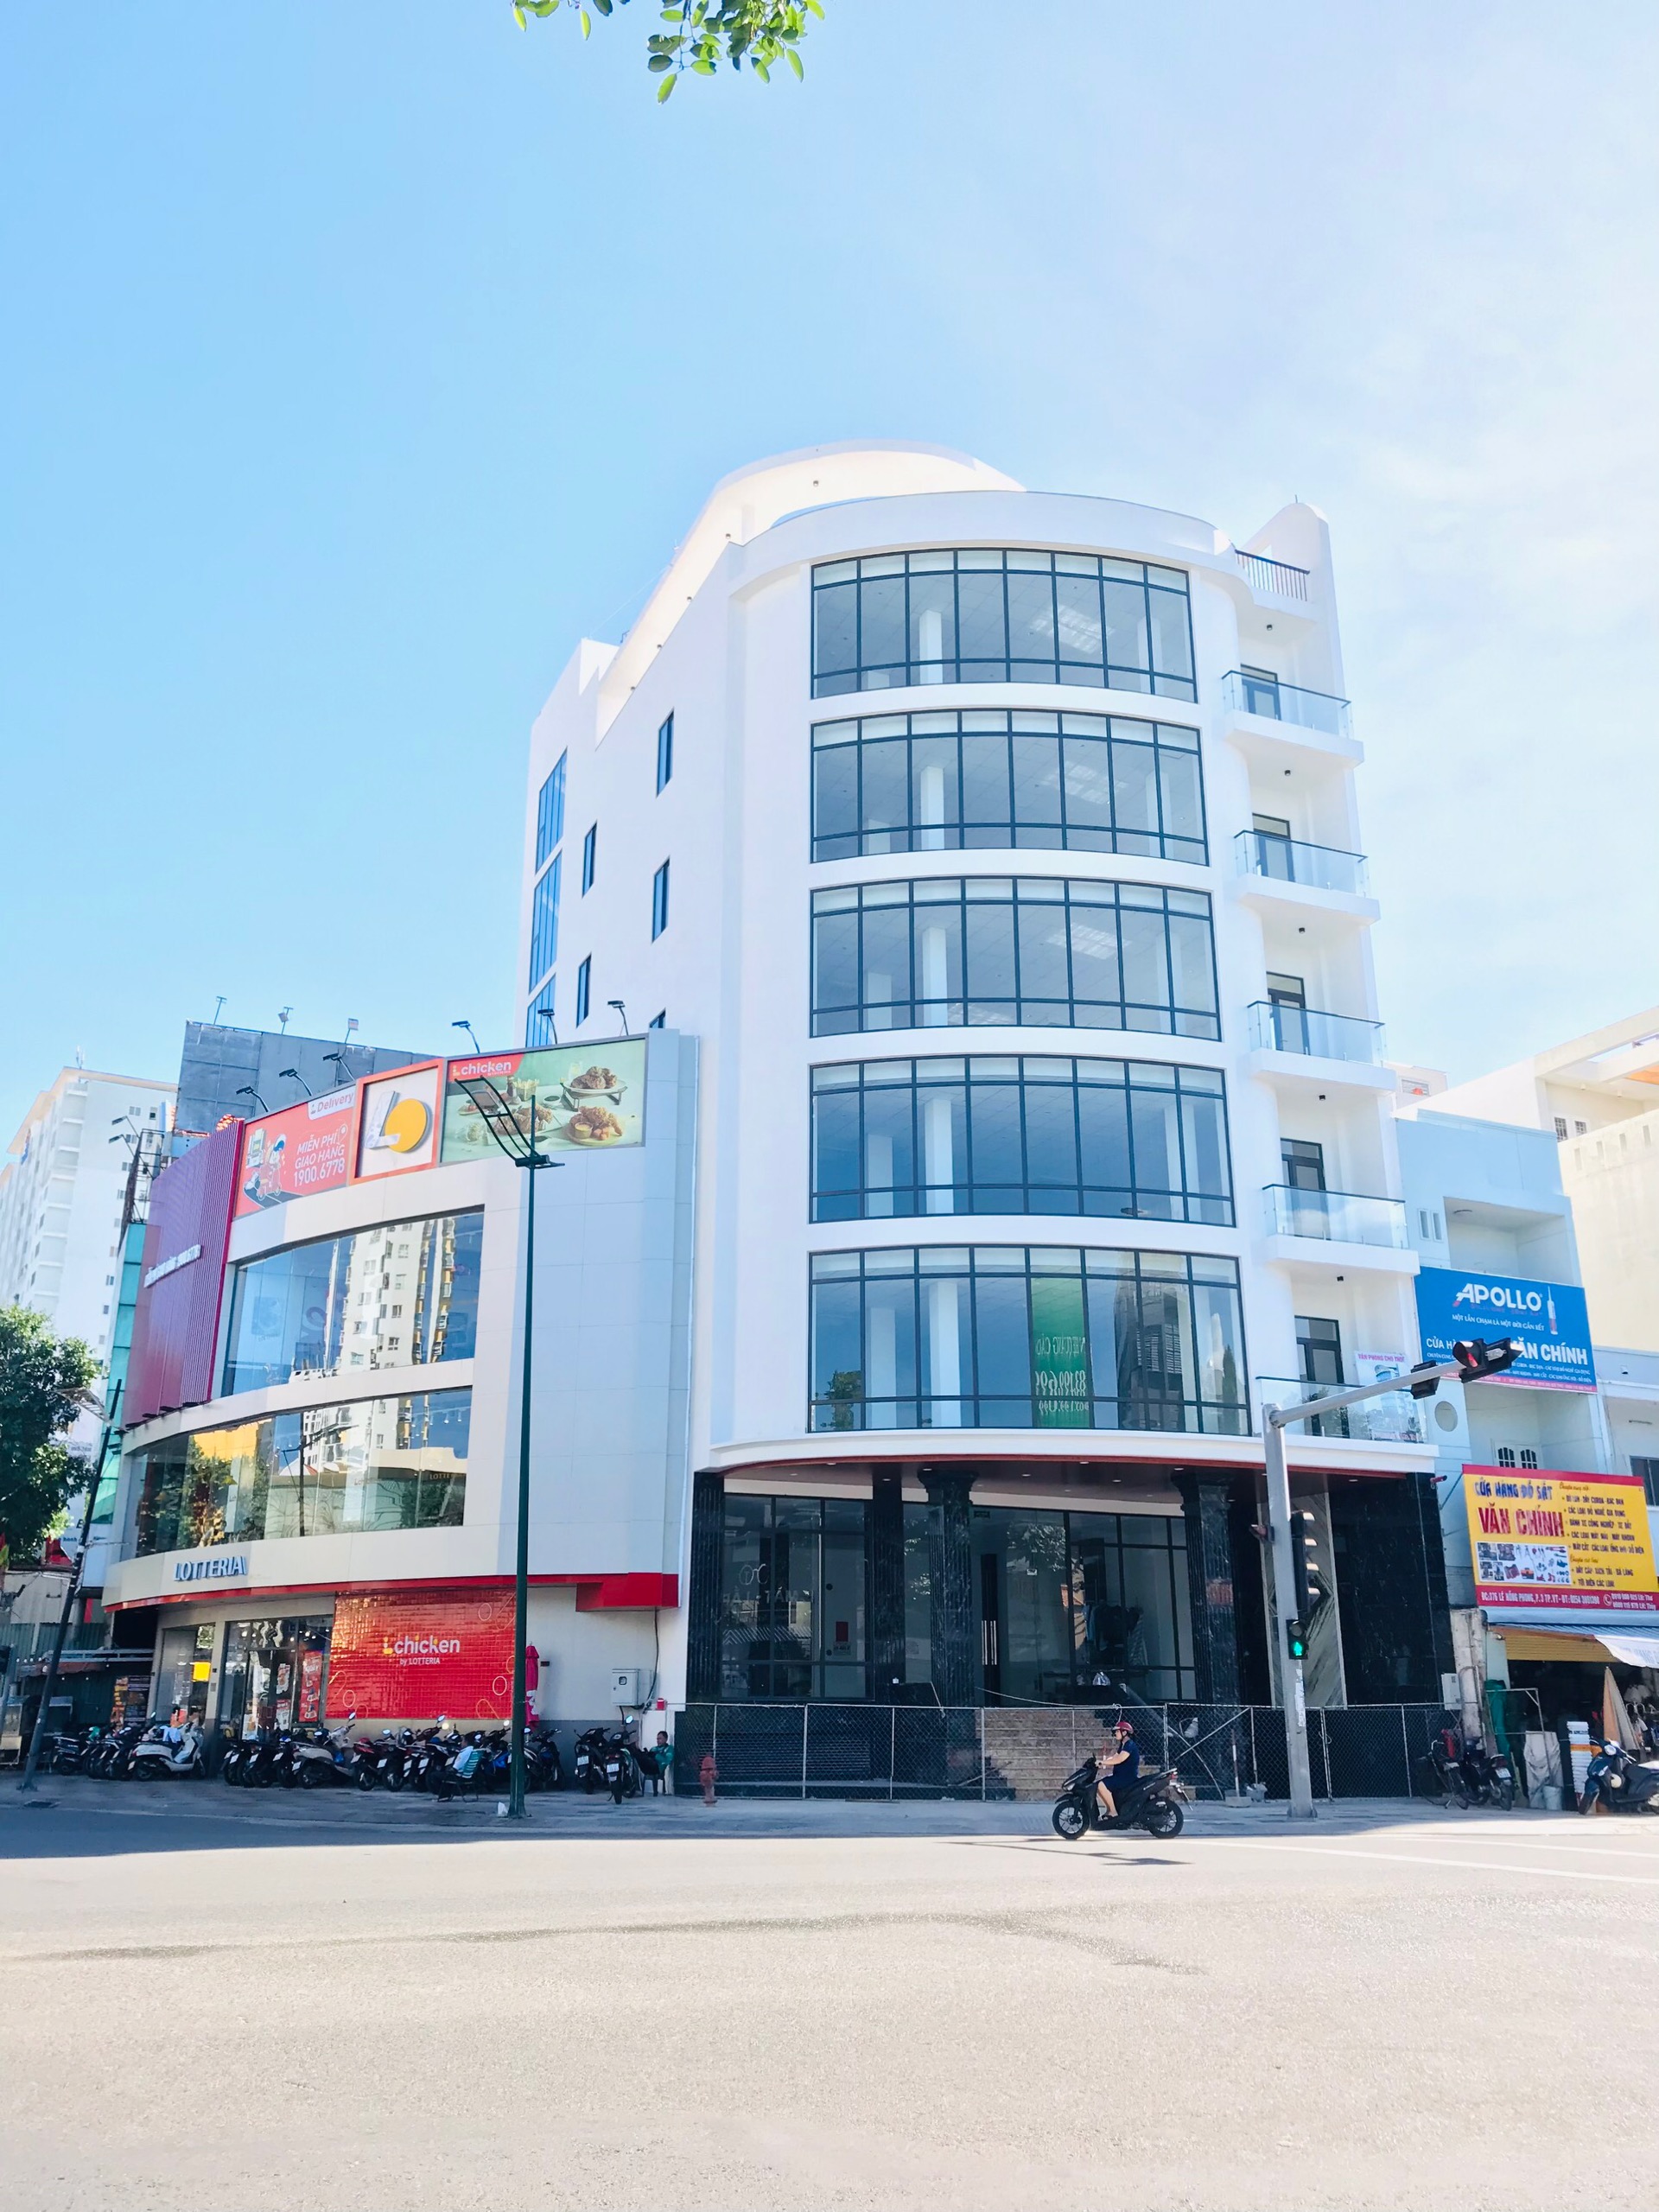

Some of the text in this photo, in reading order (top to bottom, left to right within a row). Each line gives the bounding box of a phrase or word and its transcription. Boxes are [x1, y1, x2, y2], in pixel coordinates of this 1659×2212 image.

[317, 1093, 354, 1112] Delivery
[297, 1135, 321, 1154] MIỄN
[294, 1158, 345, 1187] 1900.6778
[295, 1154, 316, 1169] GIAO
[1452, 1283, 1542, 1312] APOLLO
[1427, 1336, 1445, 1348] CỬA
[1541, 1342, 1588, 1365] CHÍNH
[1475, 1477, 1491, 1497] CỬA
[1495, 1480, 1519, 1497] HÀNG
[1478, 1502, 1565, 1536] VĂN CHÍNH
[174, 1555, 247, 1581] LOTTERIA
